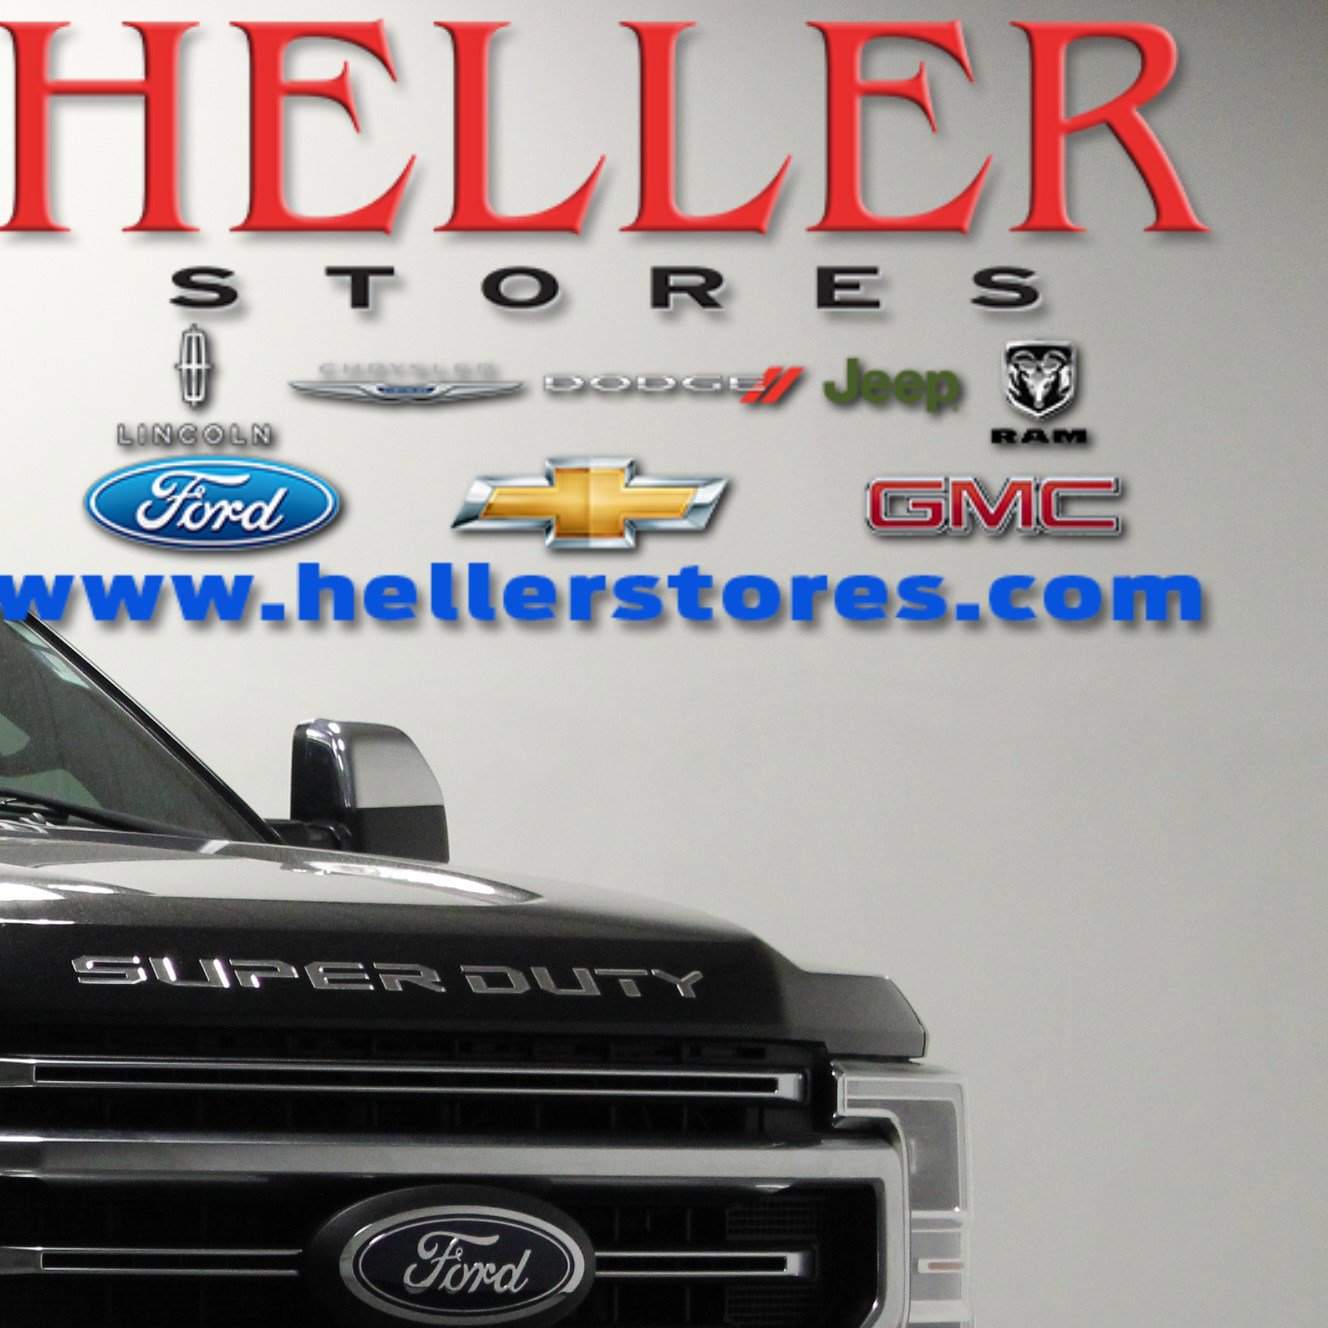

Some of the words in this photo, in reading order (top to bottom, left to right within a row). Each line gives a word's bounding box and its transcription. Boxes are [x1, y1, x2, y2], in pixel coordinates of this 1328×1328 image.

[70, 954, 446, 993] SUPER
[458, 963, 704, 999] DUTY
[403, 1230, 532, 1295] Ford
